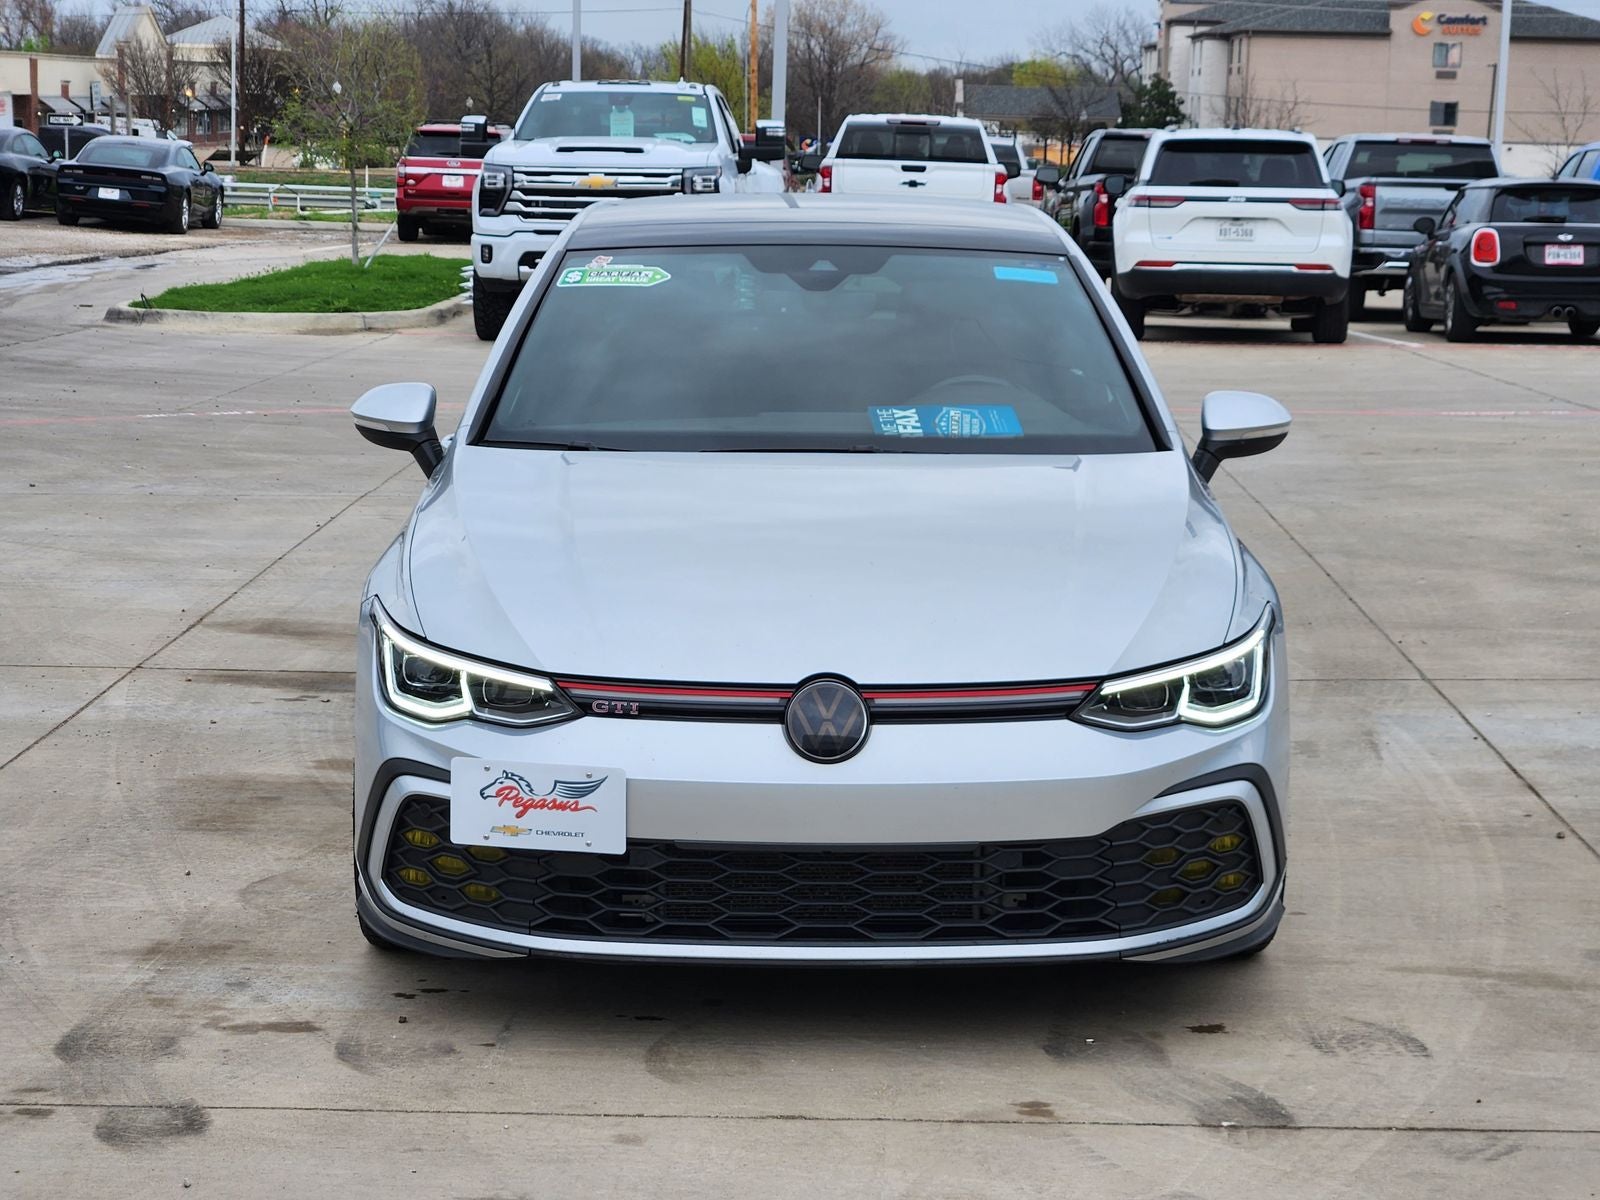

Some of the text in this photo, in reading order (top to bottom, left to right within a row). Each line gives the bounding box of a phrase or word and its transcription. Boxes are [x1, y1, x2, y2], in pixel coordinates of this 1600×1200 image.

[1437, 13, 1487, 26] Comfort
[592, 700, 639, 715] GTI
[495, 785, 597, 819] Pegasus
[535, 829, 585, 838] CHEVROLET
